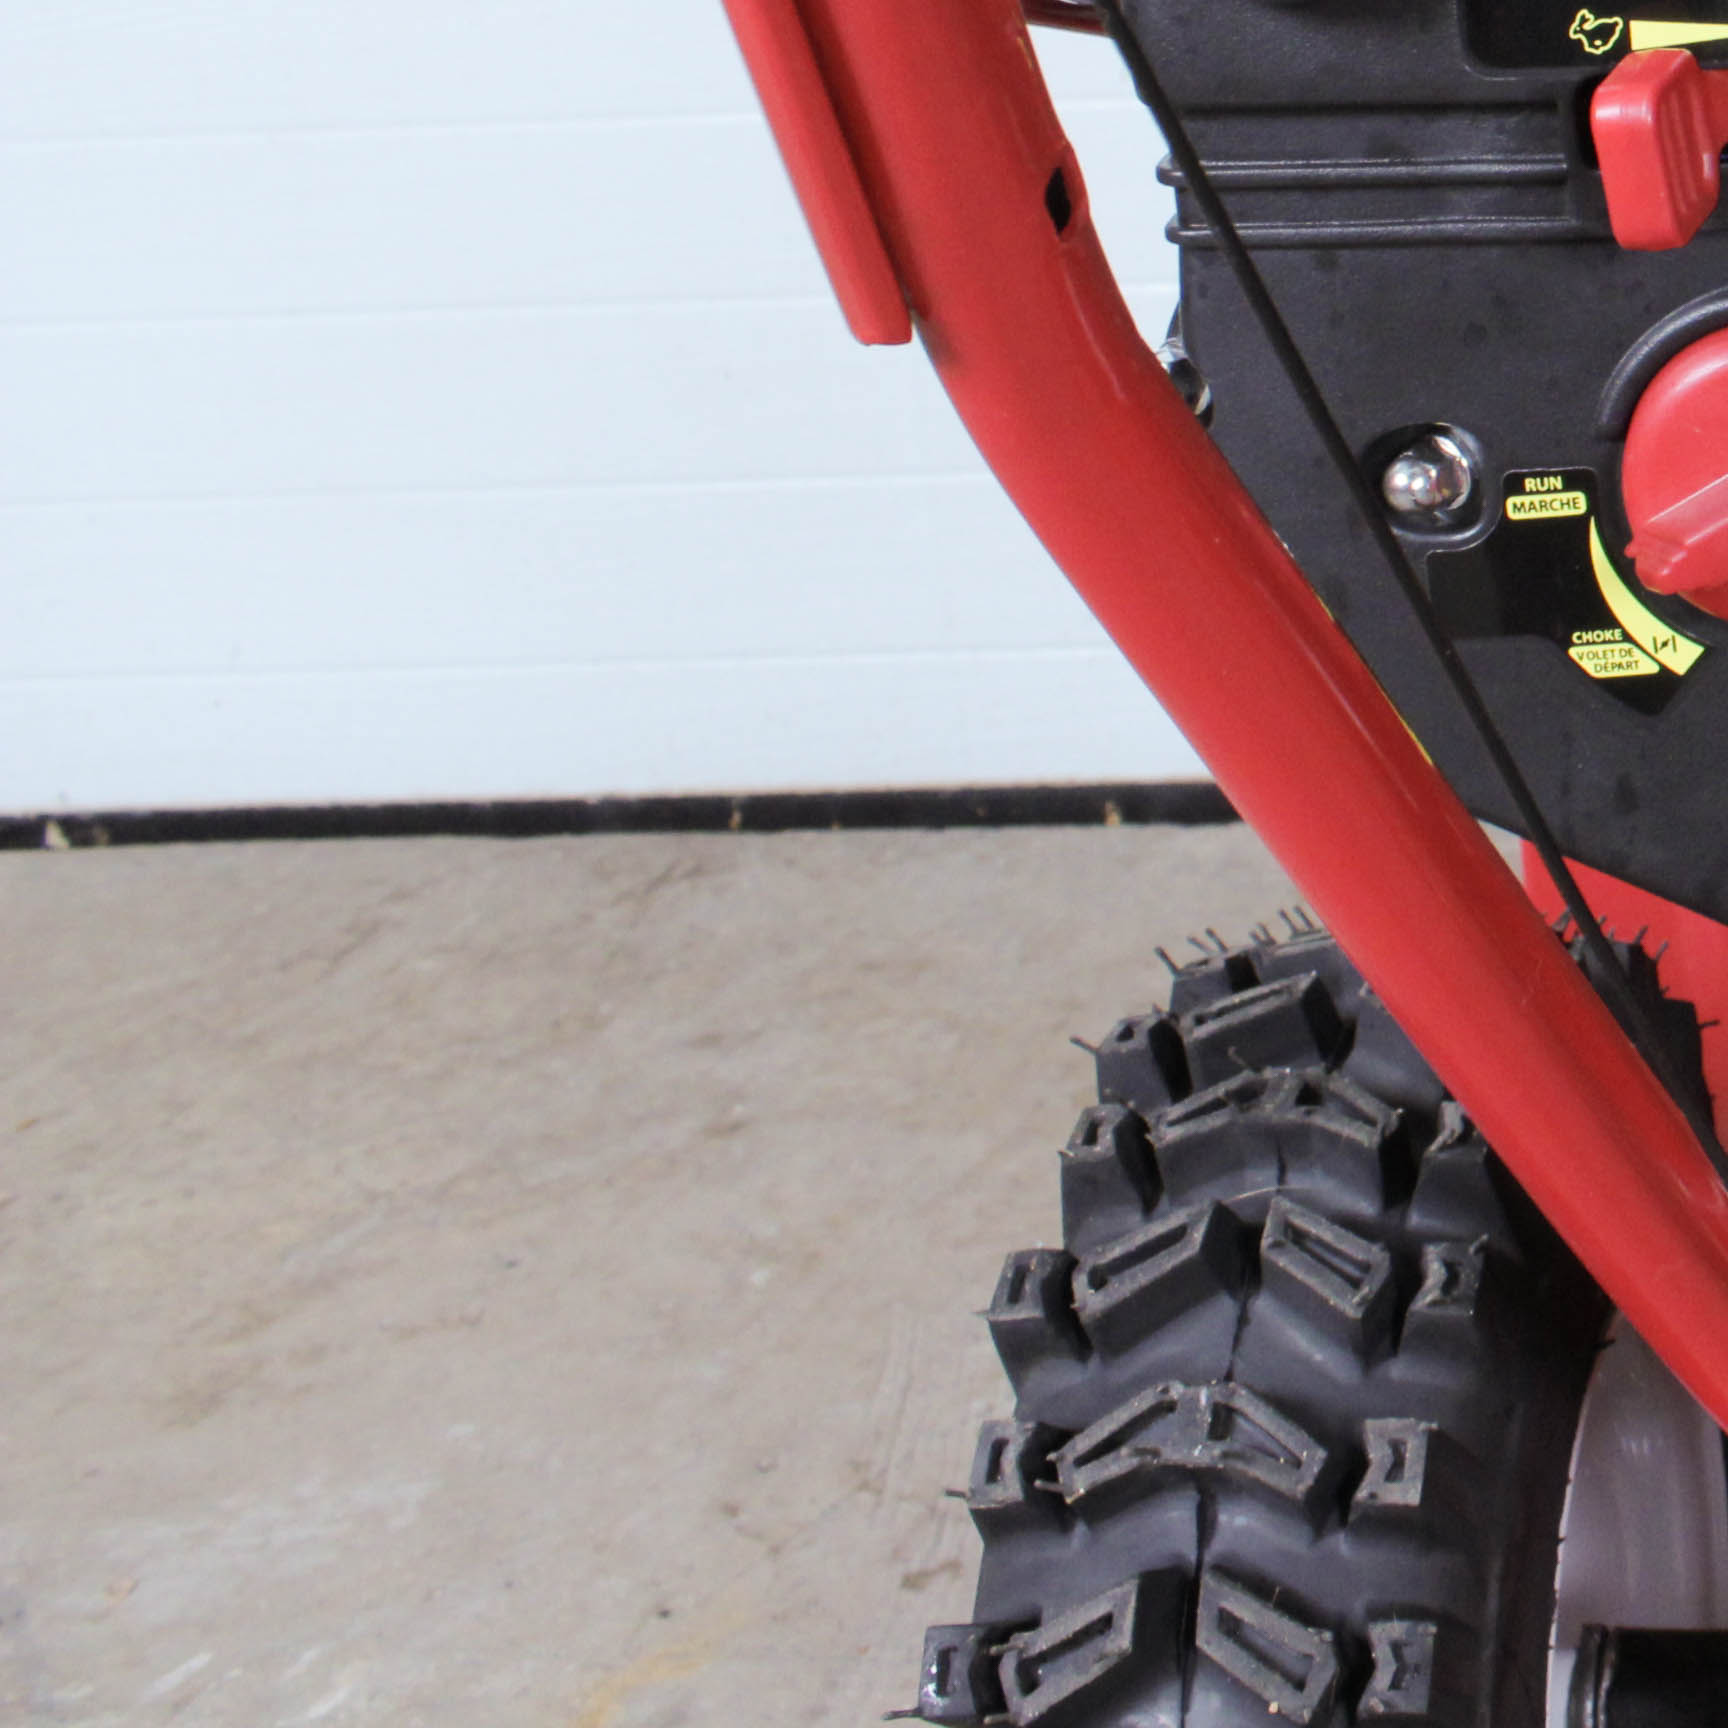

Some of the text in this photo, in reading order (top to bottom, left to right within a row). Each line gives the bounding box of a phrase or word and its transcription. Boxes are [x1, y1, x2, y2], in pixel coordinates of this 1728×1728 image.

[1524, 475, 1563, 492] RUN
[1512, 496, 1582, 514] MARCHE
[1572, 628, 1623, 644] CHOKE
[1577, 647, 1634, 662] VOLET DE
